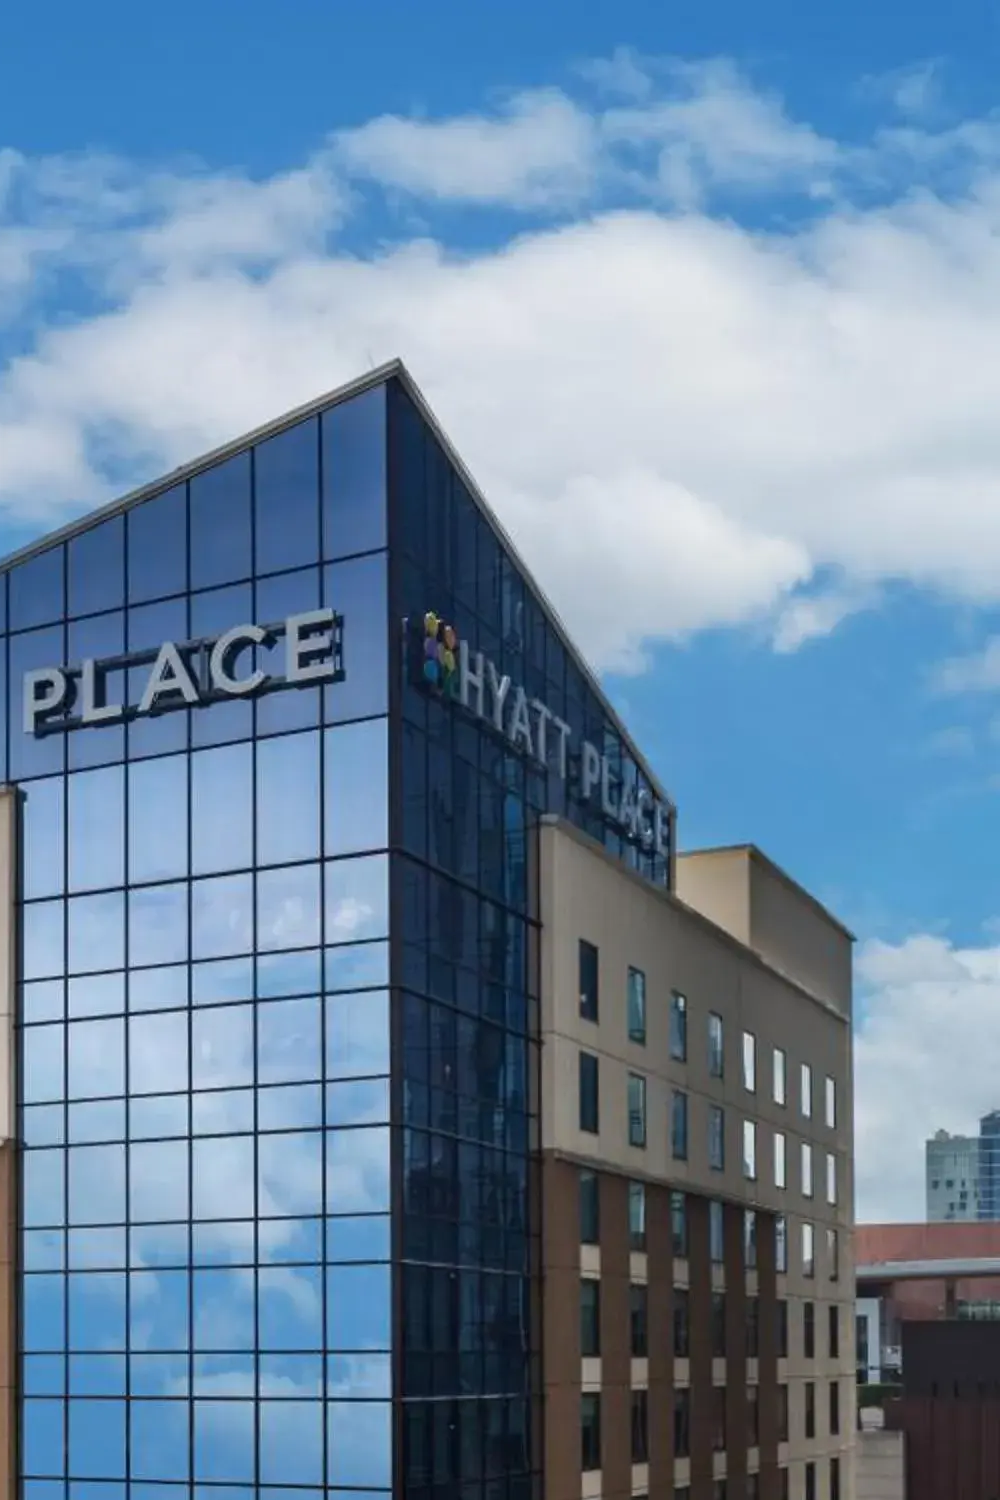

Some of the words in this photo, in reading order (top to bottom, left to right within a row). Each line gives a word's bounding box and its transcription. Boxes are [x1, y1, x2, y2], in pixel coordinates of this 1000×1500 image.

[23, 607, 338, 734] PLACE
[459, 640, 572, 780] HYATT
[582, 740, 668, 851] PLACE
